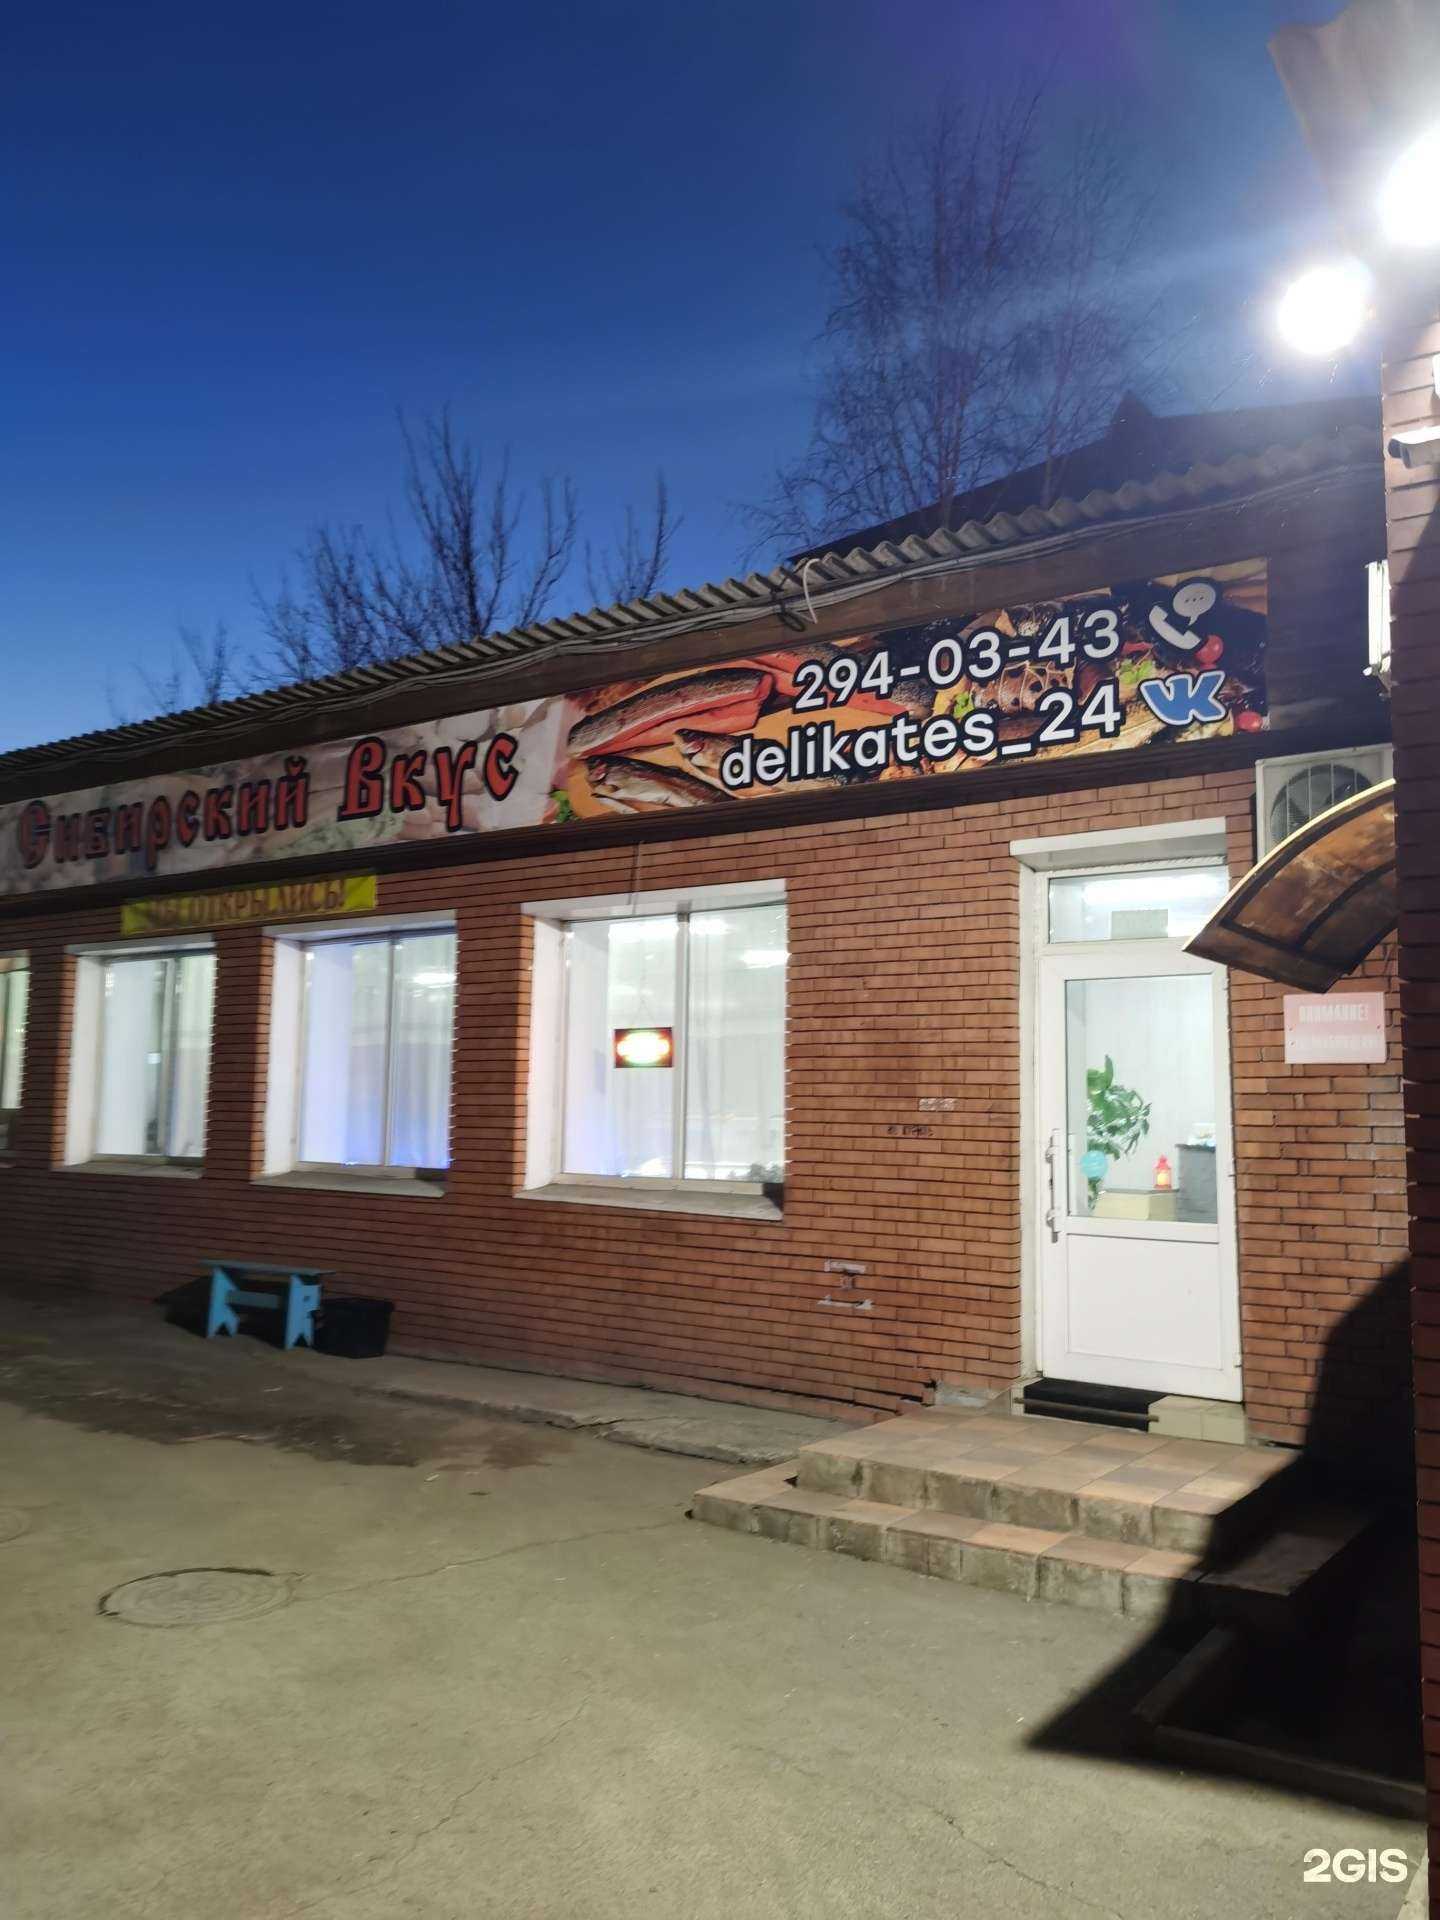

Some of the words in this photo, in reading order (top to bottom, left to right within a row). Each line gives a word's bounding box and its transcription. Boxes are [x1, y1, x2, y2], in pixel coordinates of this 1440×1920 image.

[795, 608, 1120, 713] 294-03-43
[338, 733, 519, 833] Вкус
[721, 685, 1121, 787] delikates_24
